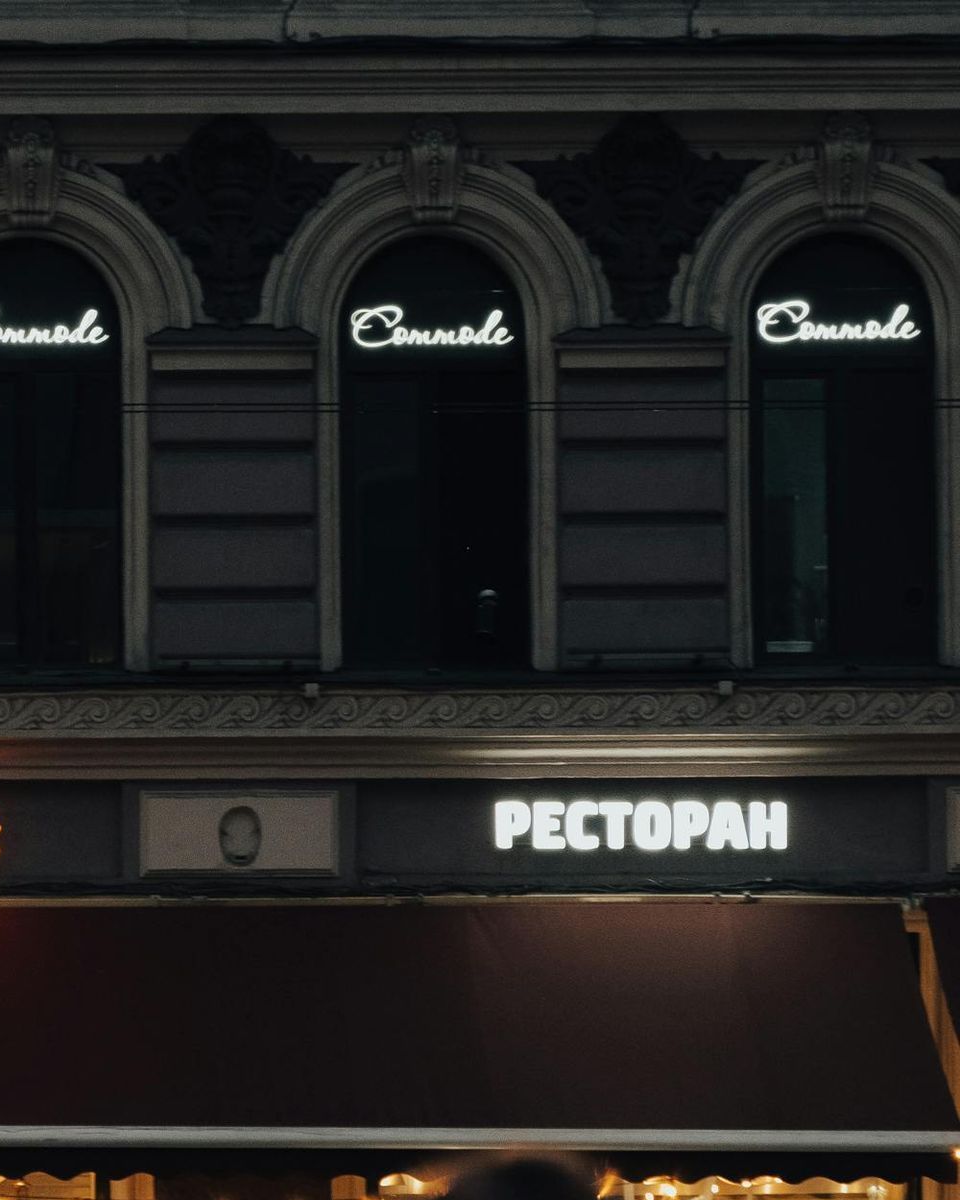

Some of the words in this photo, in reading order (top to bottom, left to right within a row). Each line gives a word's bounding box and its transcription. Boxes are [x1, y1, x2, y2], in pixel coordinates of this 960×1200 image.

[350, 304, 515, 348] Commode
[756, 299, 922, 344] Commode
[493, 798, 789, 852] РЕСТОРАН
